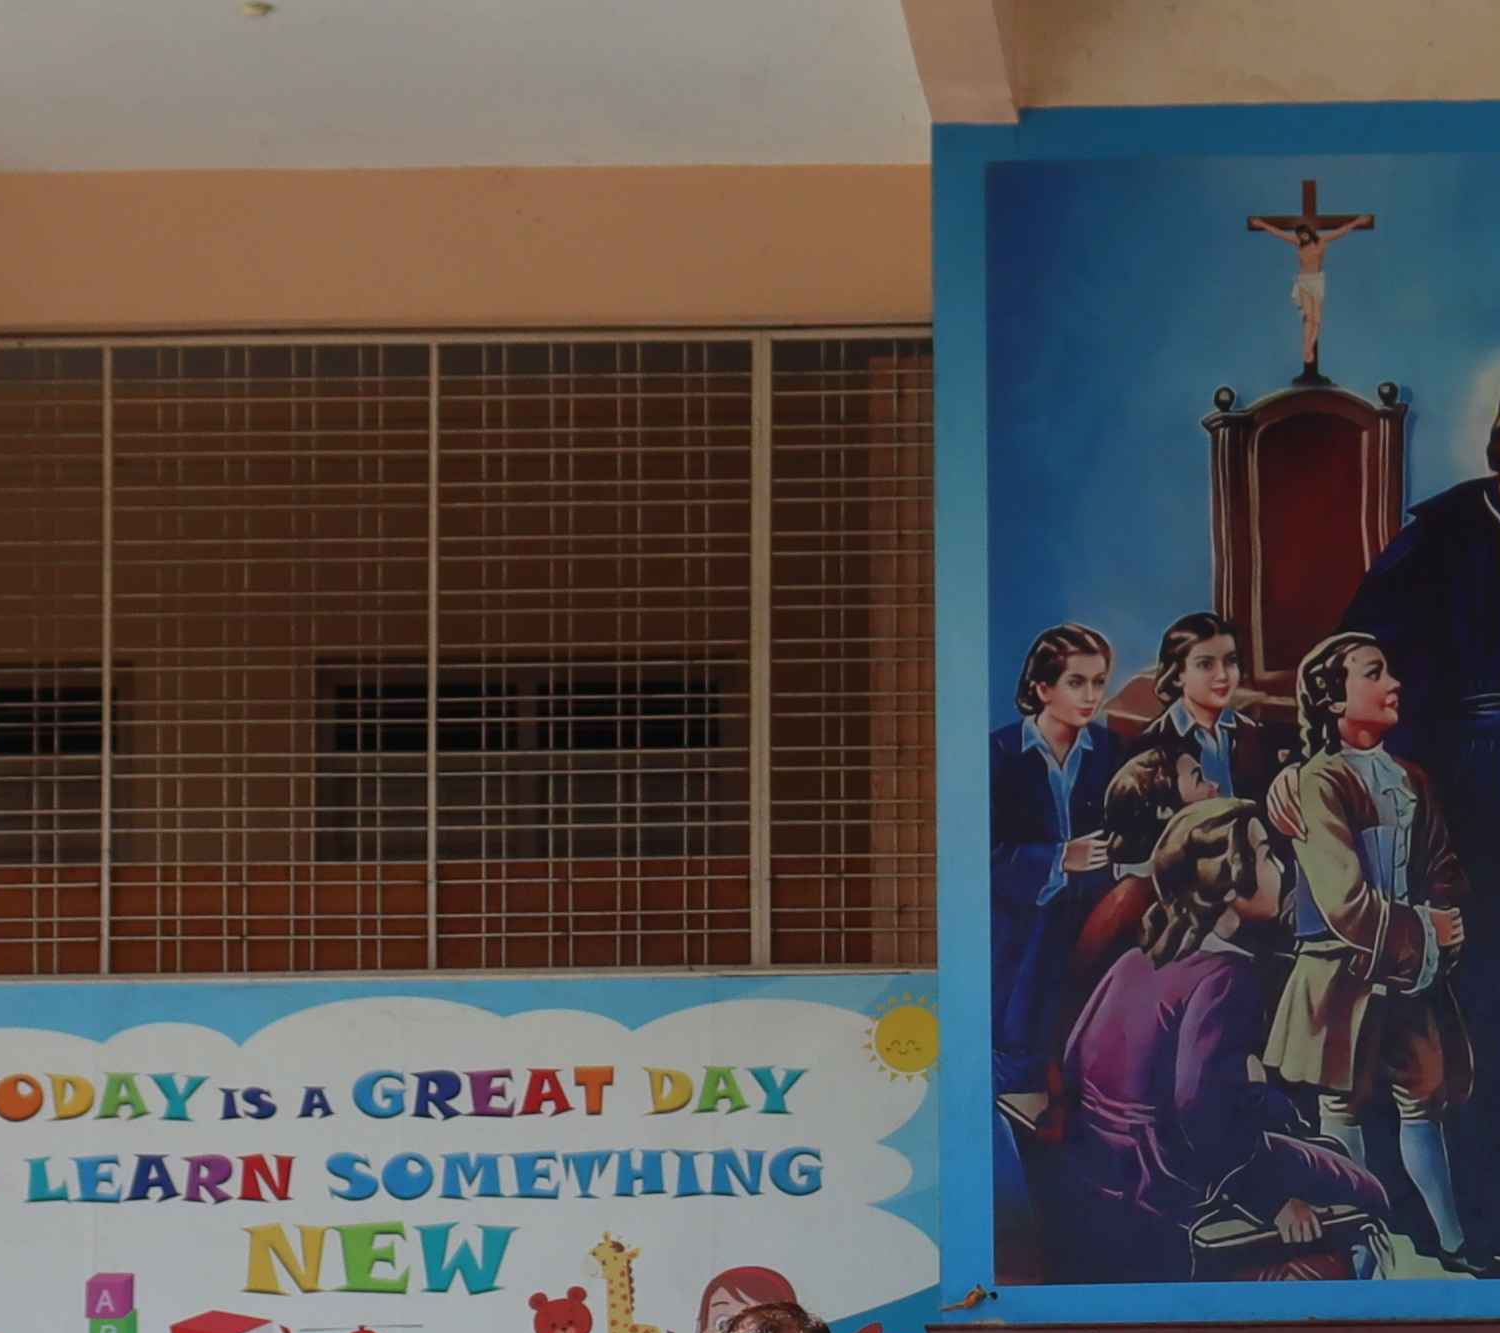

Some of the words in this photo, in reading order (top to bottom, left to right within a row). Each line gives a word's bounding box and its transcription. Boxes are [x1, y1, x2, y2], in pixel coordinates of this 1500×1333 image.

[219, 1087, 277, 1120] IS
[300, 1087, 334, 1117] A
[352, 1065, 613, 1117] GREAT
[644, 1066, 808, 1116] DAY
[23, 1155, 296, 1204] LEARN
[326, 1148, 823, 1199] SOMETHING
[240, 1222, 517, 1296] NEW
[96, 1291, 114, 1313] A
